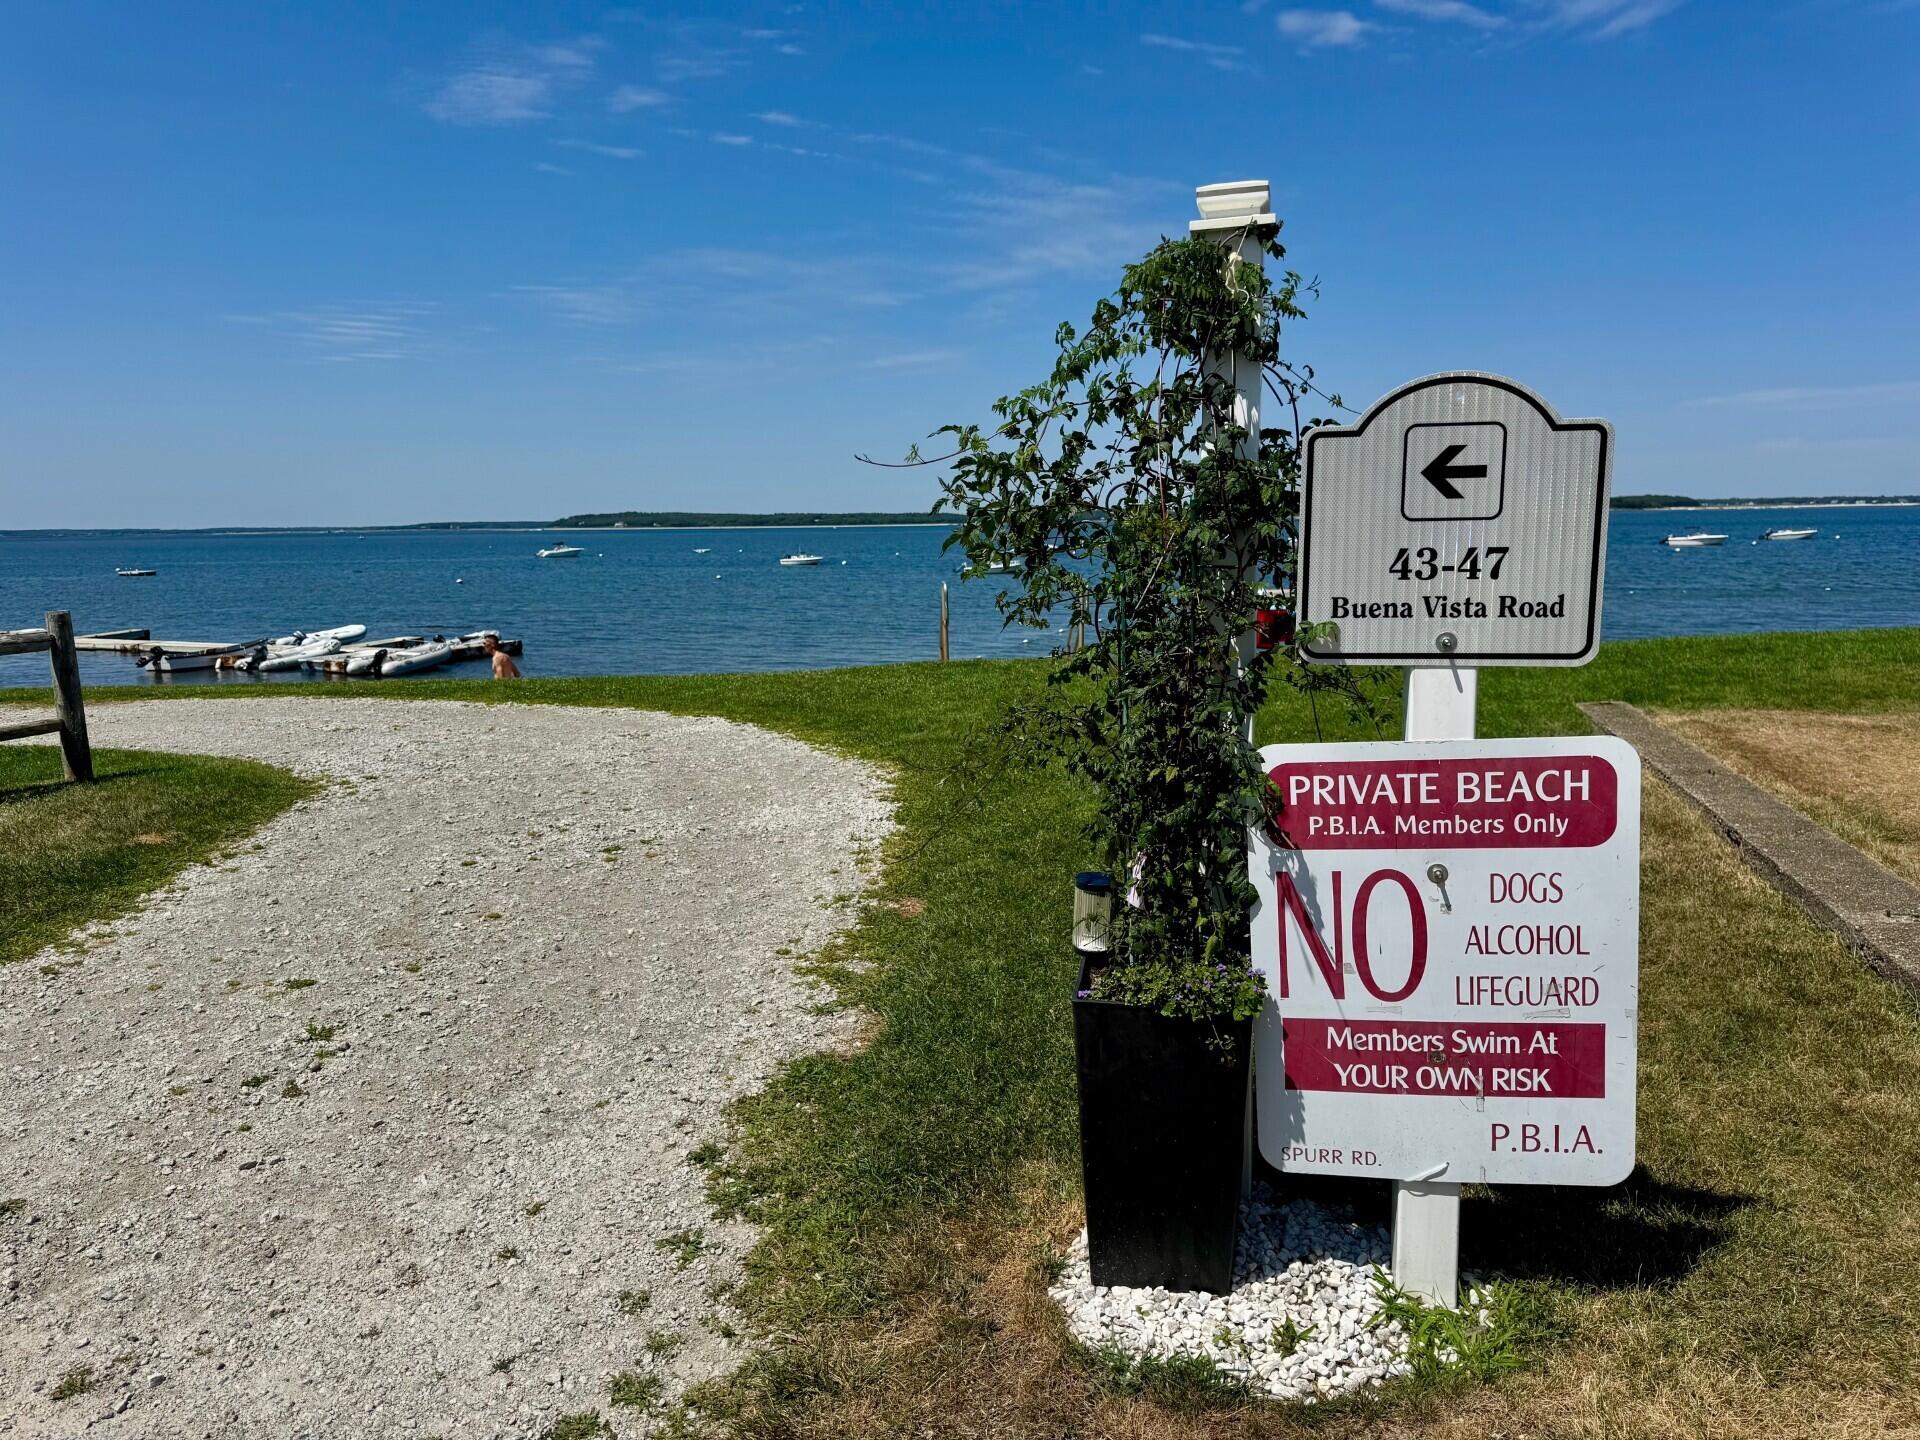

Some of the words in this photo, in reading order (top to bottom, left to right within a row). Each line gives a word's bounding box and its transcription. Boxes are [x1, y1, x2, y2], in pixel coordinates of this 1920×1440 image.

[1388, 546, 1510, 581] 43-47
[1331, 596, 1413, 619] Buena
[1422, 595, 1488, 619] Vista
[1497, 593, 1565, 618] Road
[1288, 772, 1440, 806] PRIVATE
[1457, 769, 1590, 803] BEACH
[1308, 815, 1385, 836] P.B.I.A.
[1395, 814, 1505, 835] Members
[1514, 813, 1569, 838] Only
[1490, 872, 1563, 904] DOGS
[1275, 867, 1428, 1003] NO
[1464, 924, 1590, 955] ALCOHOL
[1455, 975, 1600, 1007] LIFEGUARD
[1326, 1026, 1445, 1052] Members
[1451, 1029, 1520, 1054] Swim
[1528, 1031, 1558, 1055] At
[1333, 1063, 1408, 1089] YOUR
[1415, 1066, 1483, 1091] OWN
[1491, 1067, 1552, 1092] RISK
[1490, 1123, 1604, 1155] P.B.I.A.
[1281, 1146, 1343, 1165] SPURR
[1352, 1149, 1382, 1167] RD.
